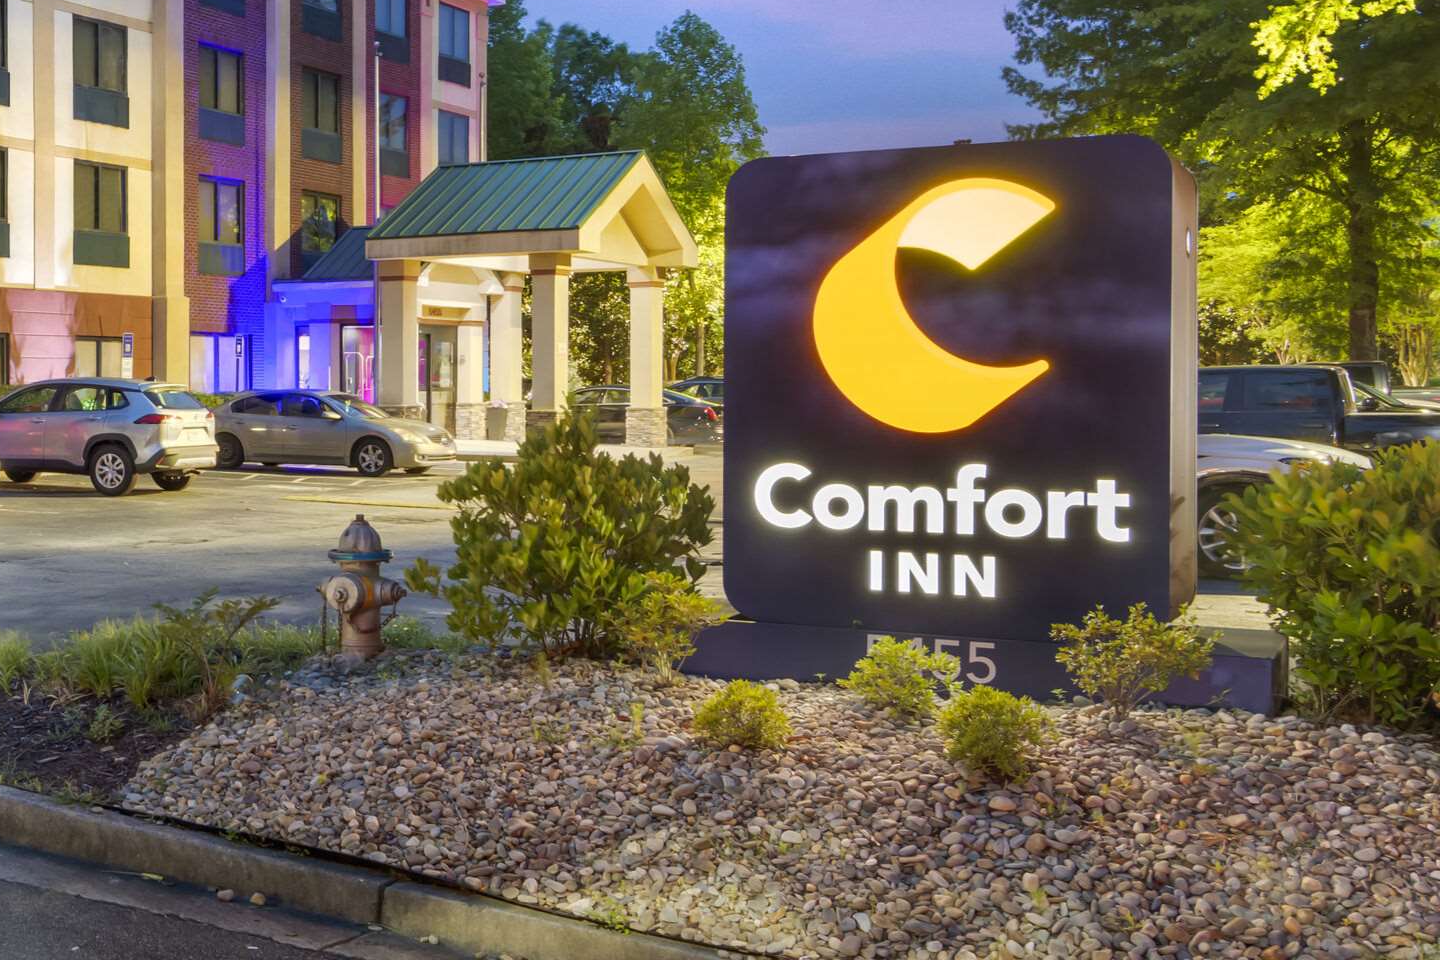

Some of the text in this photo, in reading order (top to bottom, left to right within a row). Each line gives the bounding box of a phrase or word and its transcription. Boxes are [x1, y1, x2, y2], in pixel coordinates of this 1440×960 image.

[754, 462, 1130, 542] Comfort
[870, 550, 995, 598] INN
[866, 633, 997, 685] 55
